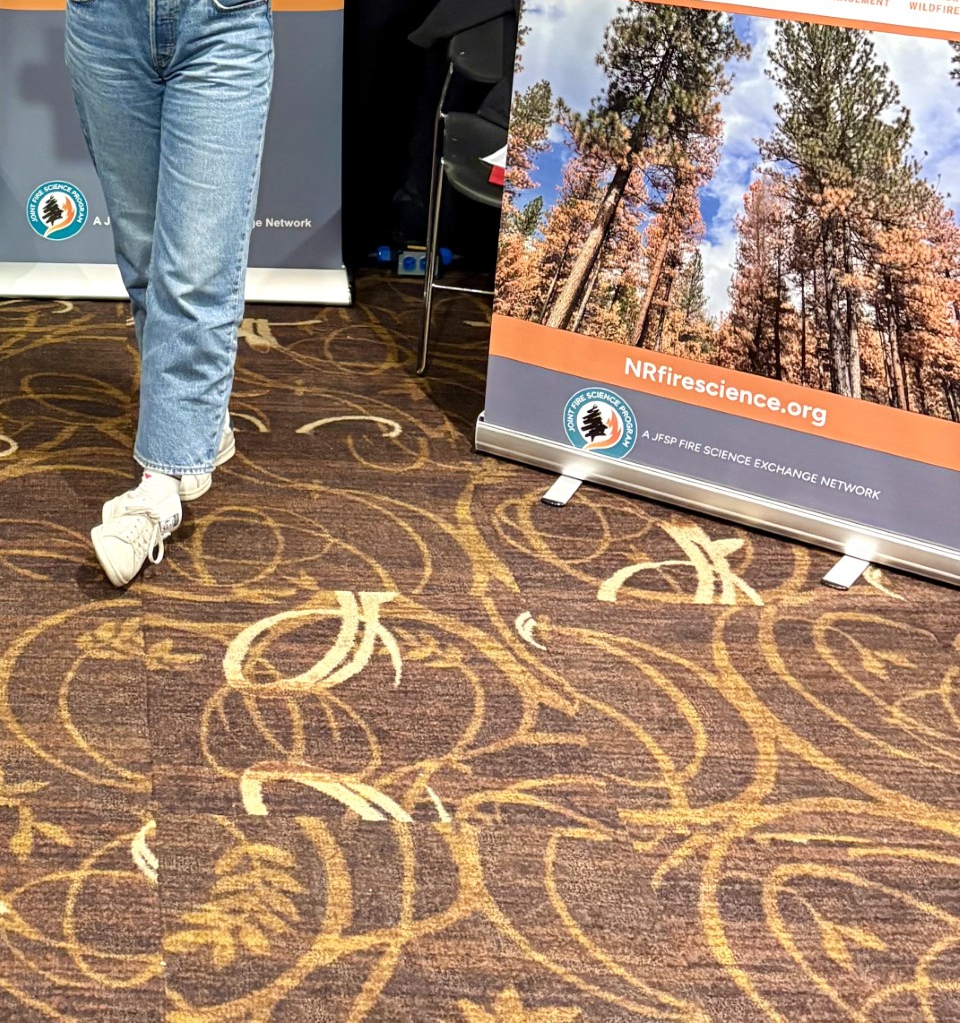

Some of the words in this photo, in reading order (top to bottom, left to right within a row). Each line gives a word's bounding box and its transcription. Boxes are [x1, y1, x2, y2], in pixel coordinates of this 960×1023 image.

[909, 1, 960, 16] WILDFIRE
[32, 189, 44, 203] FIRE
[43, 183, 72, 193] SCIENCE
[29, 203, 38, 222] JOINT
[71, 190, 85, 224] PROGRAM
[93, 216, 102, 226] A
[265, 217, 312, 228] Network
[586, 391, 621, 407] SCIENCE
[624, 357, 828, 427] NRfirescience.org
[571, 394, 587, 409] FIRE
[567, 408, 576, 432] JOINT
[618, 405, 634, 448] PROGRAM
[641, 430, 650, 440] A
[652, 432, 678, 446] JFSP
[679, 438, 702, 453] FIRE
[703, 444, 752, 467] SCIENCE
[754, 457, 818, 484] EXCHANGE
[820, 474, 882, 501] NETWORK
